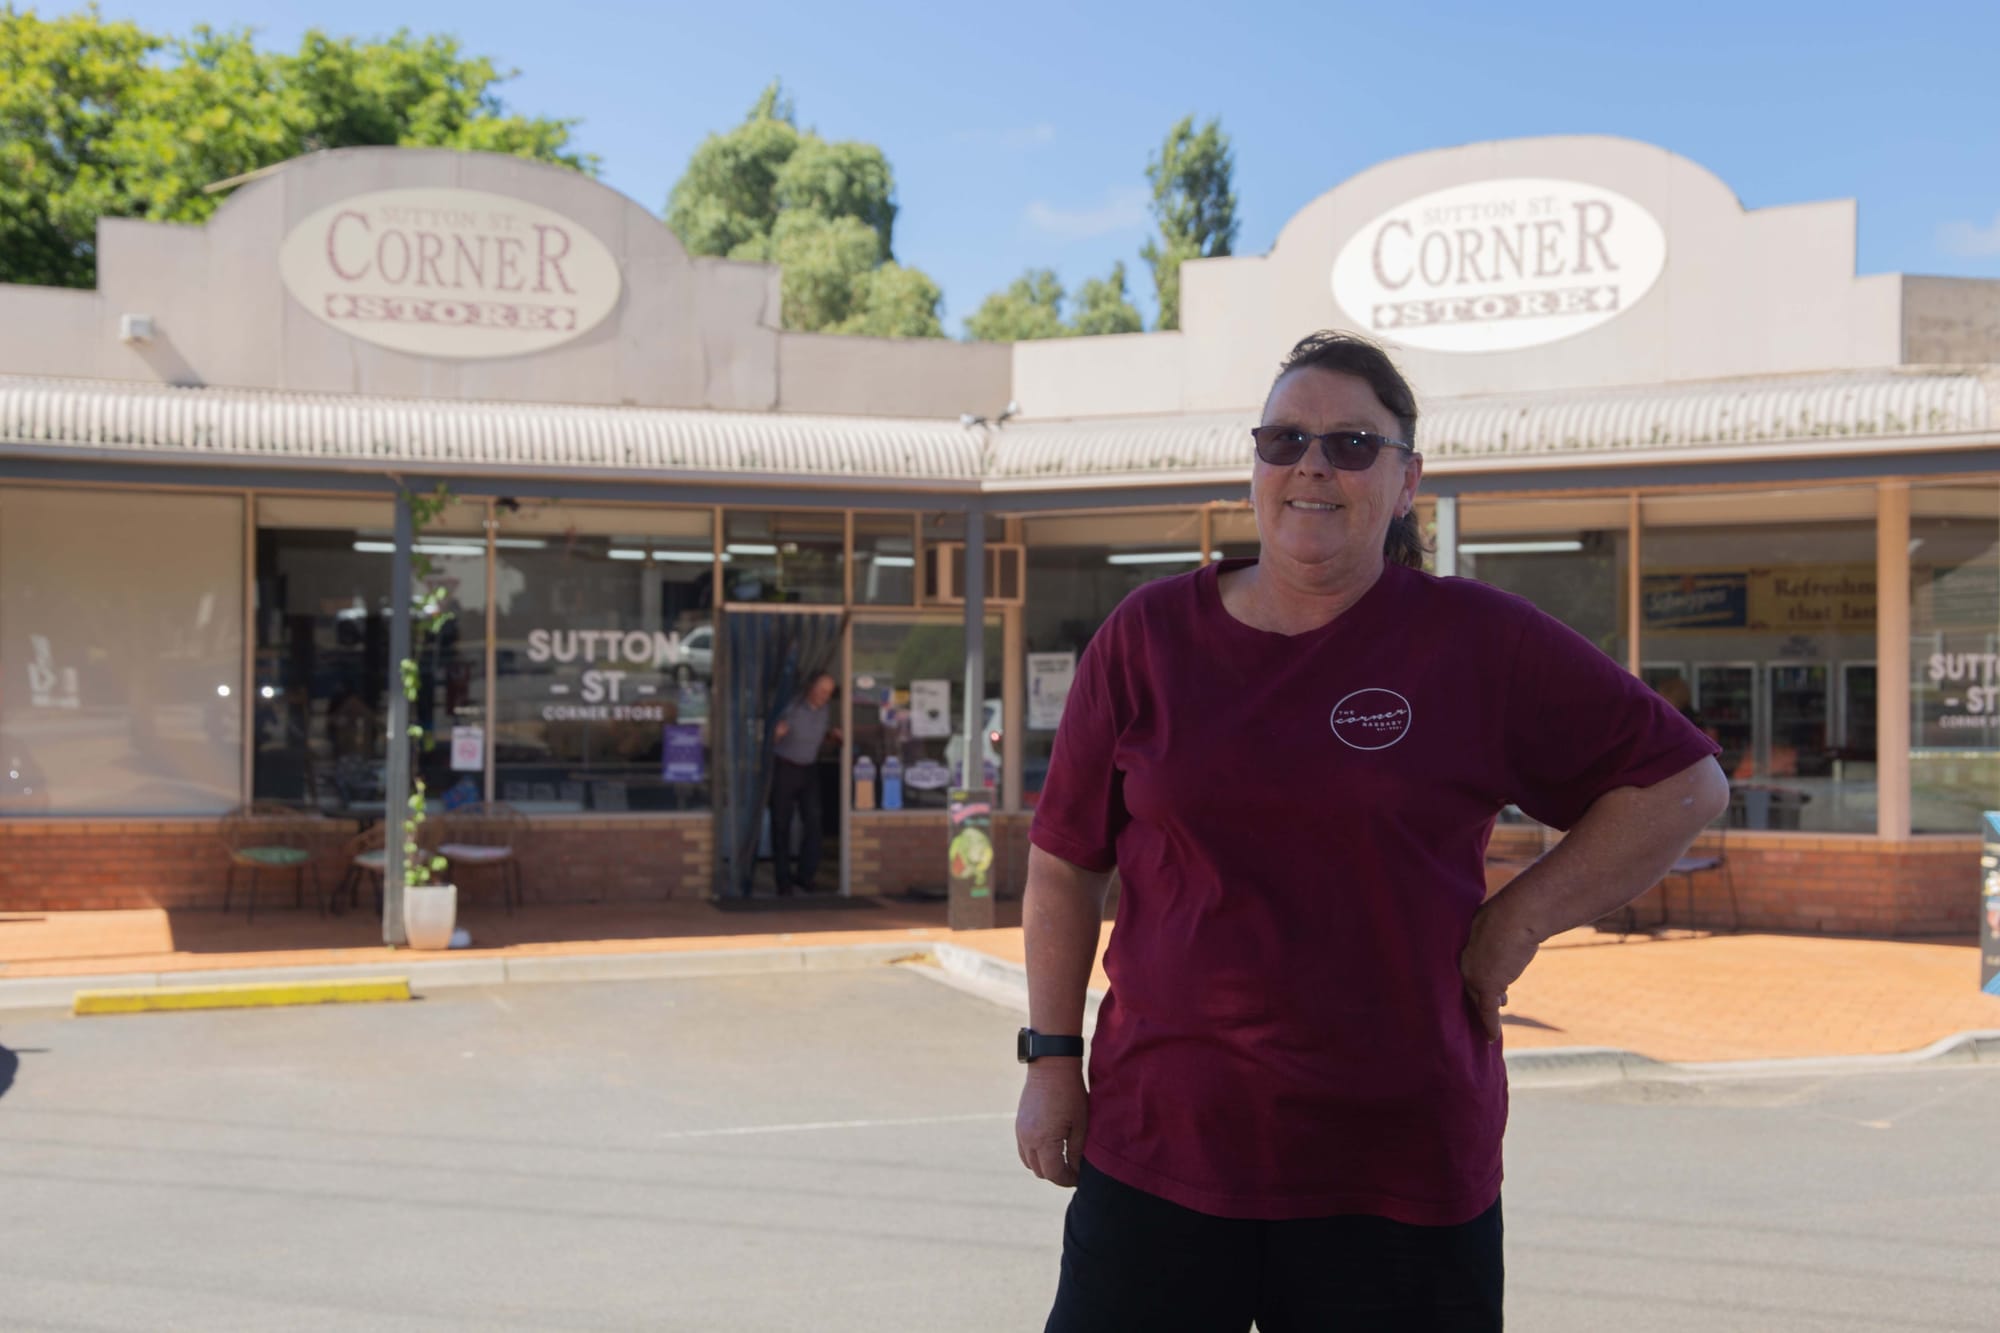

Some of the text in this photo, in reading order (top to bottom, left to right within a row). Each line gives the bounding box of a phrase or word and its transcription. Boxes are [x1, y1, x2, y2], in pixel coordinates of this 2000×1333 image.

[1423, 200, 1516, 225] SUTTON
[325, 209, 577, 295] CORNER
[1372, 200, 1620, 291] CORNER
[354, 297, 549, 328] STORE
[1402, 289, 1591, 324] STORE
[527, 629, 681, 663] SUTTON
[1927, 653, 2000, 680] SUTT
[581, 670, 626, 701] ST
[1966, 685, 1999, 714] ST
[542, 705, 664, 720] CORNER STORE
[1335, 709, 1407, 724] corner
[1938, 715, 1987, 728] CORNER
